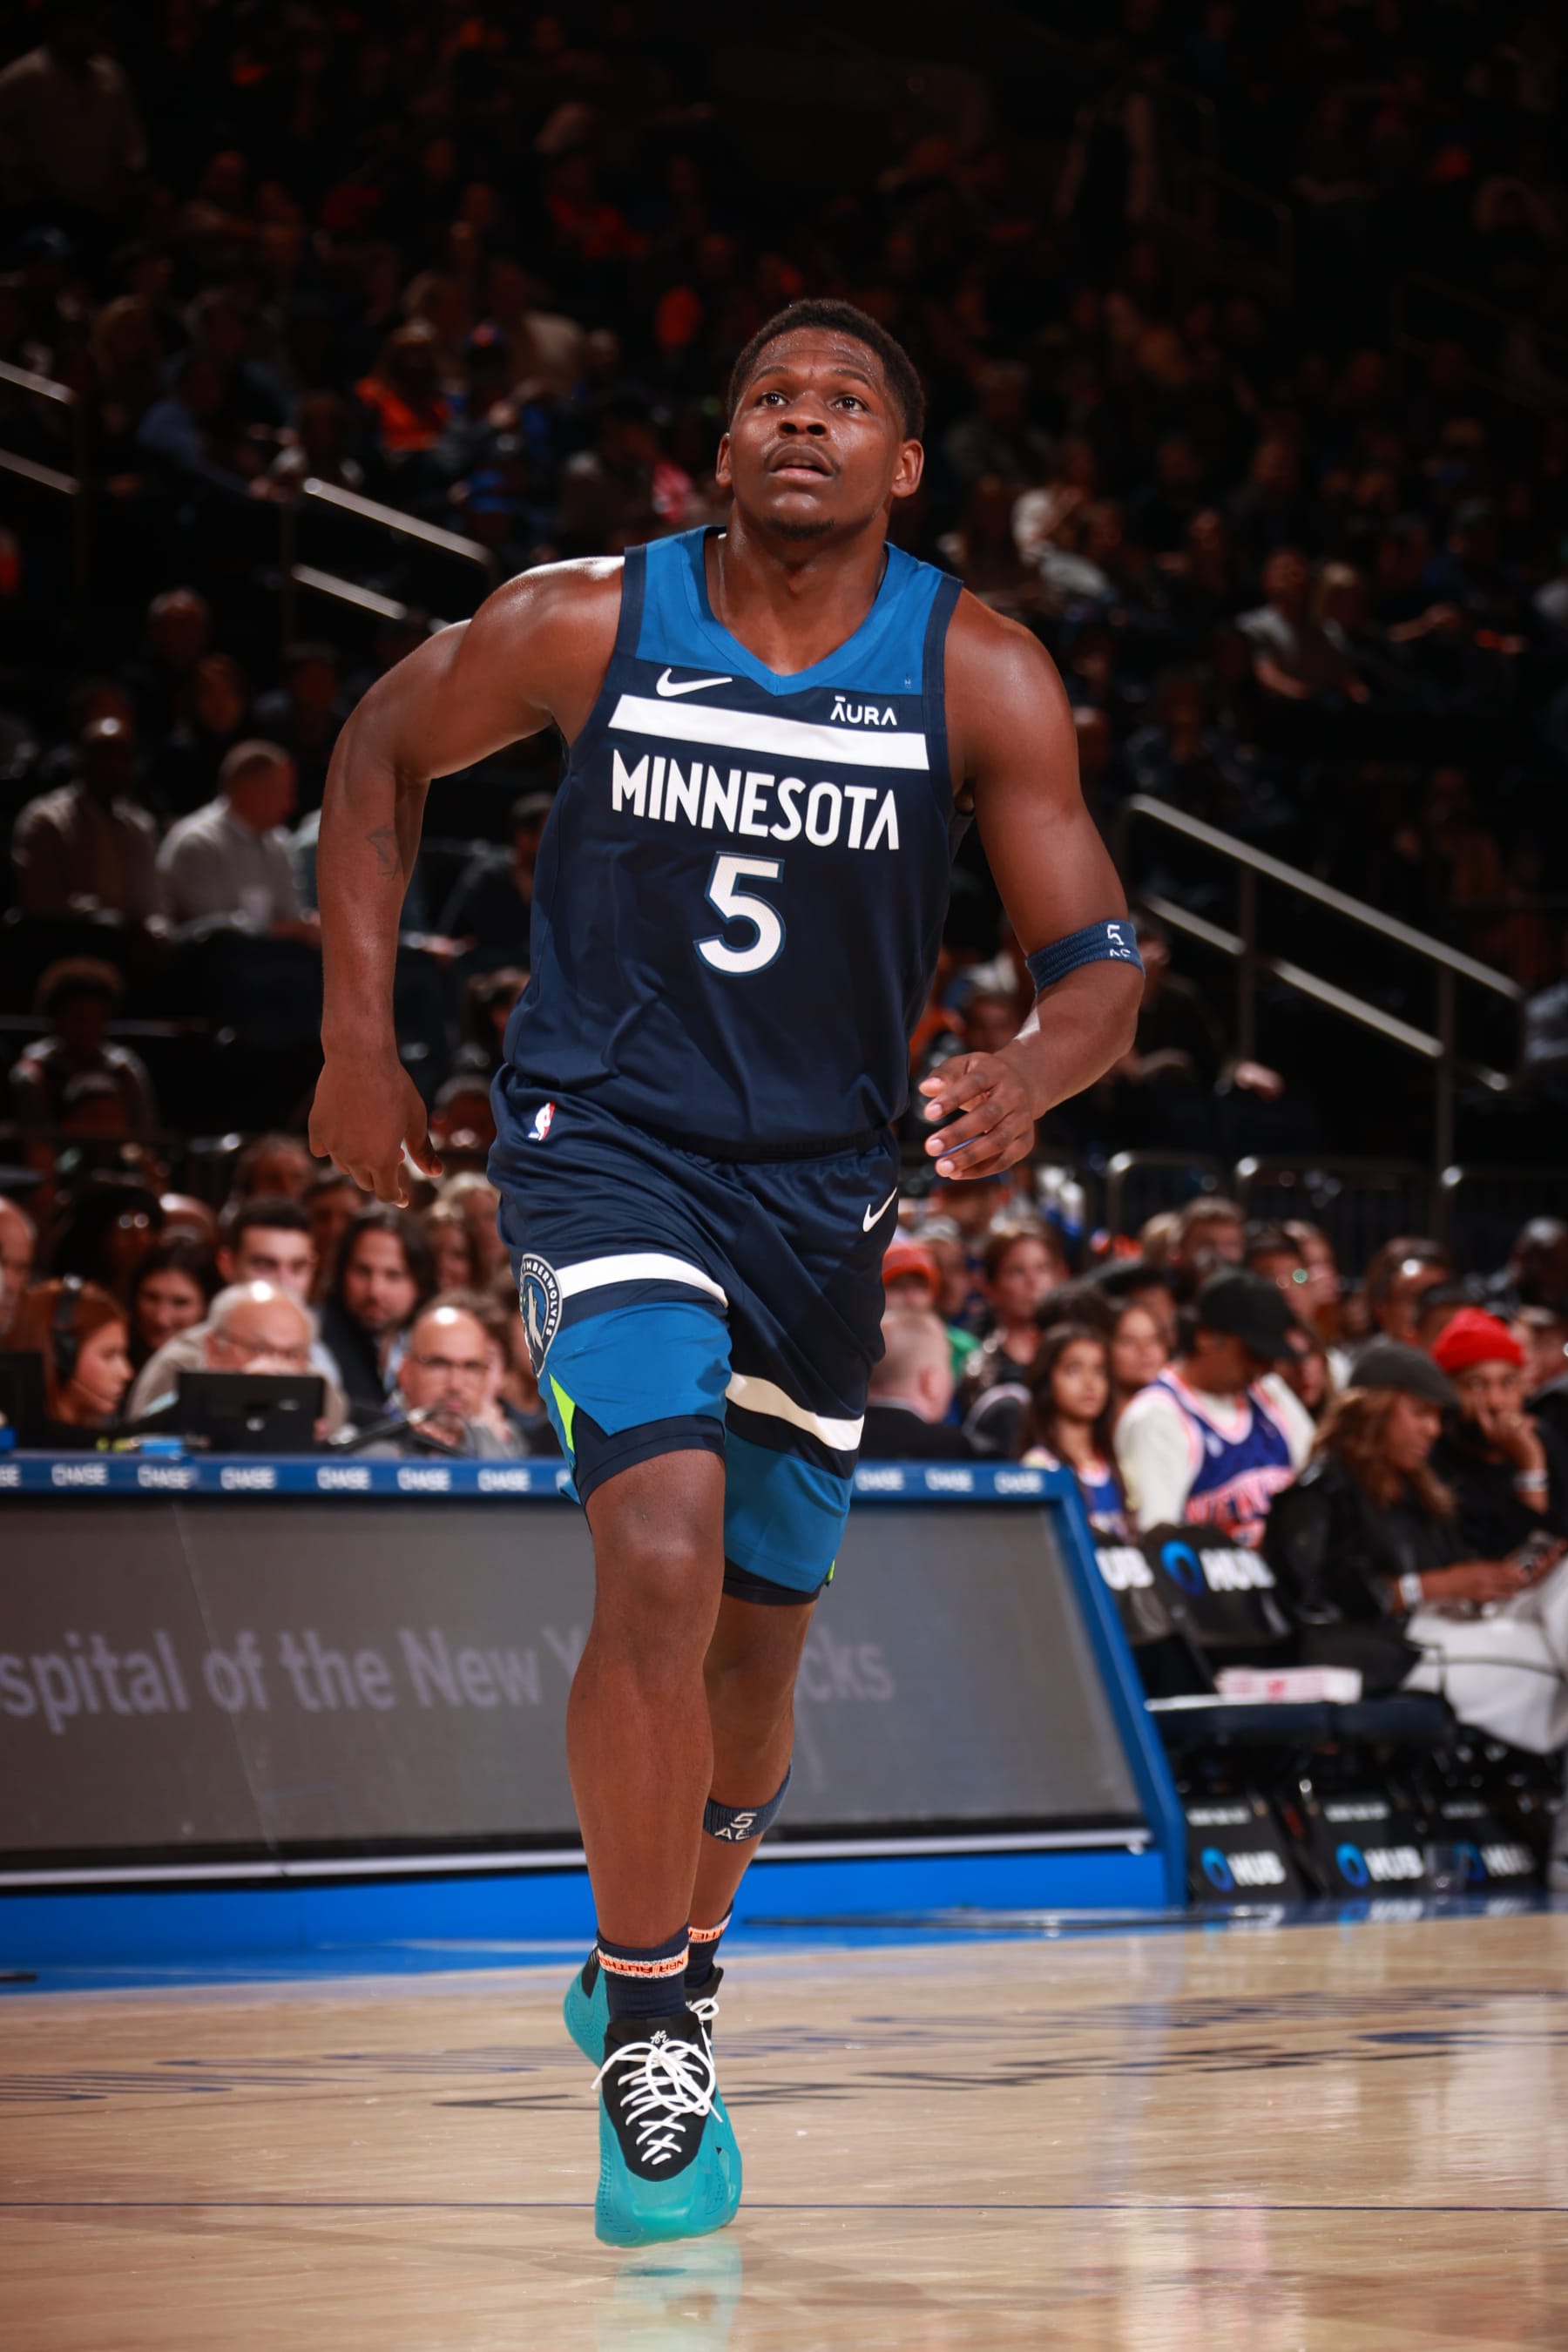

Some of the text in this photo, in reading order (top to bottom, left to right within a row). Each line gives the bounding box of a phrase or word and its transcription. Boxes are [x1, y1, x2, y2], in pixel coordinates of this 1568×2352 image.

[612, 749, 900, 850] MINNESOTA
[696, 853, 785, 975] 5
[1107, 924, 1125, 945] 5
[523, 1260, 558, 1336] IMBERWOLVES
[202, 1630, 268, 1713] of
[278, 1628, 396, 1713] the
[398, 1627, 543, 1708] New
[798, 1624, 896, 1702] cks
